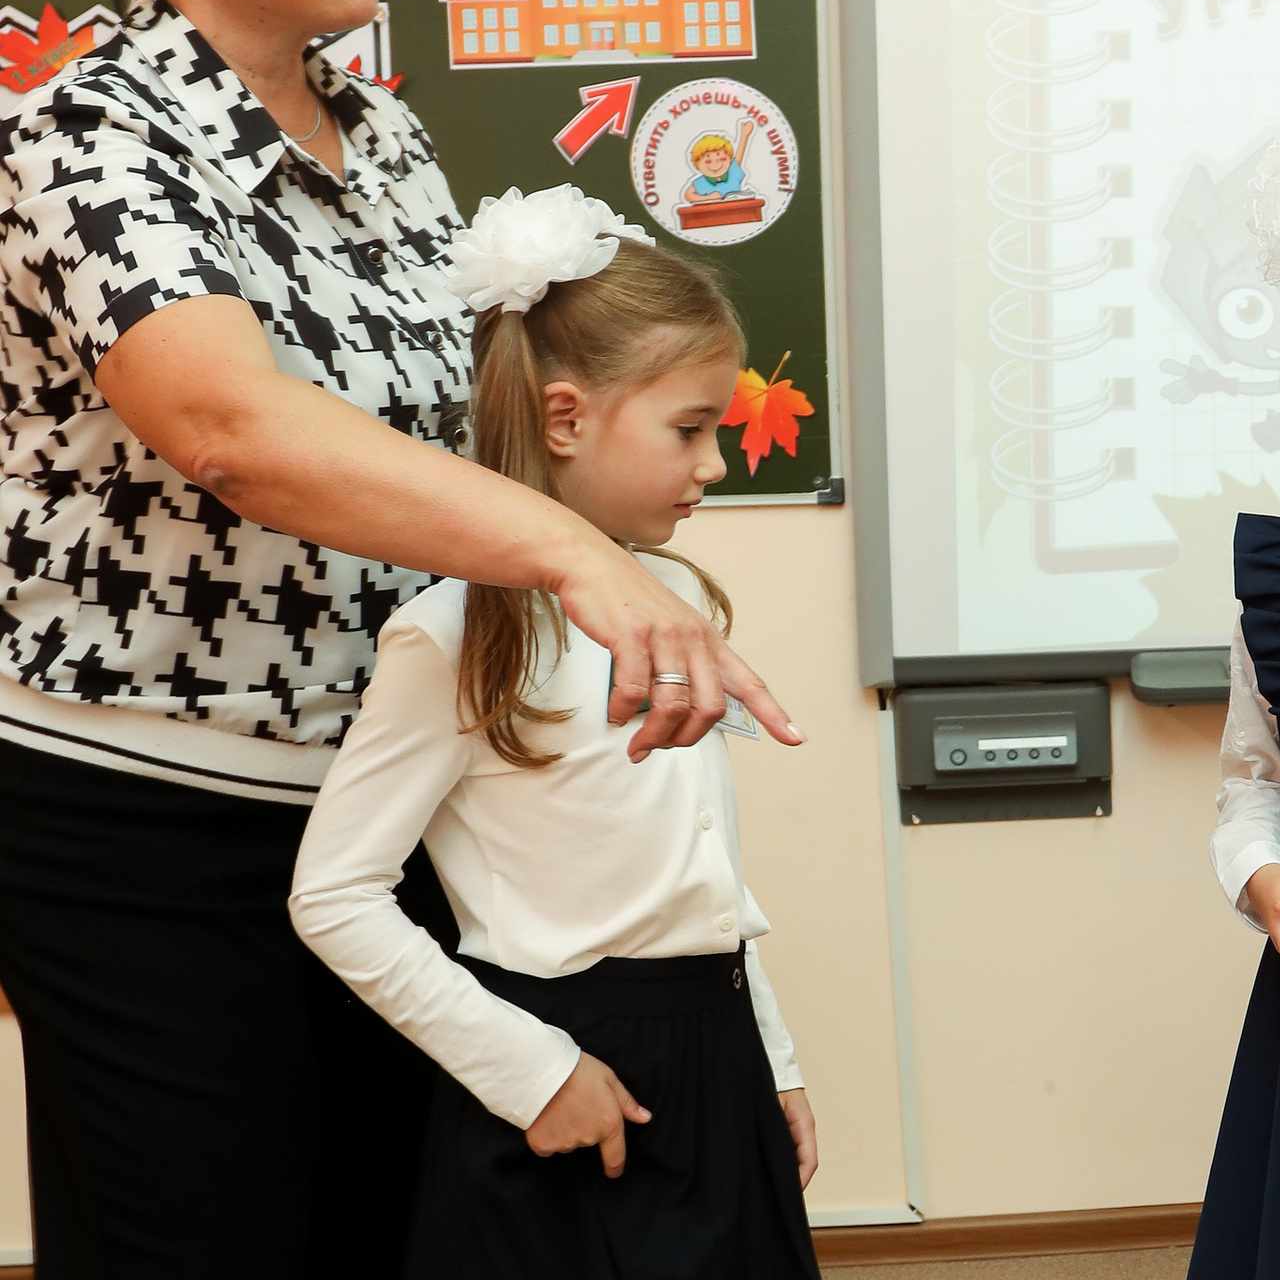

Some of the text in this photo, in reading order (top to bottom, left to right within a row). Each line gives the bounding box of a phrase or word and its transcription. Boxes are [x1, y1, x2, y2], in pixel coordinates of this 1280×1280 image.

[12, 36, 78, 86] 1 класс
[643, 118, 671, 207] Ответить
[766, 127, 795, 194] шуми!
